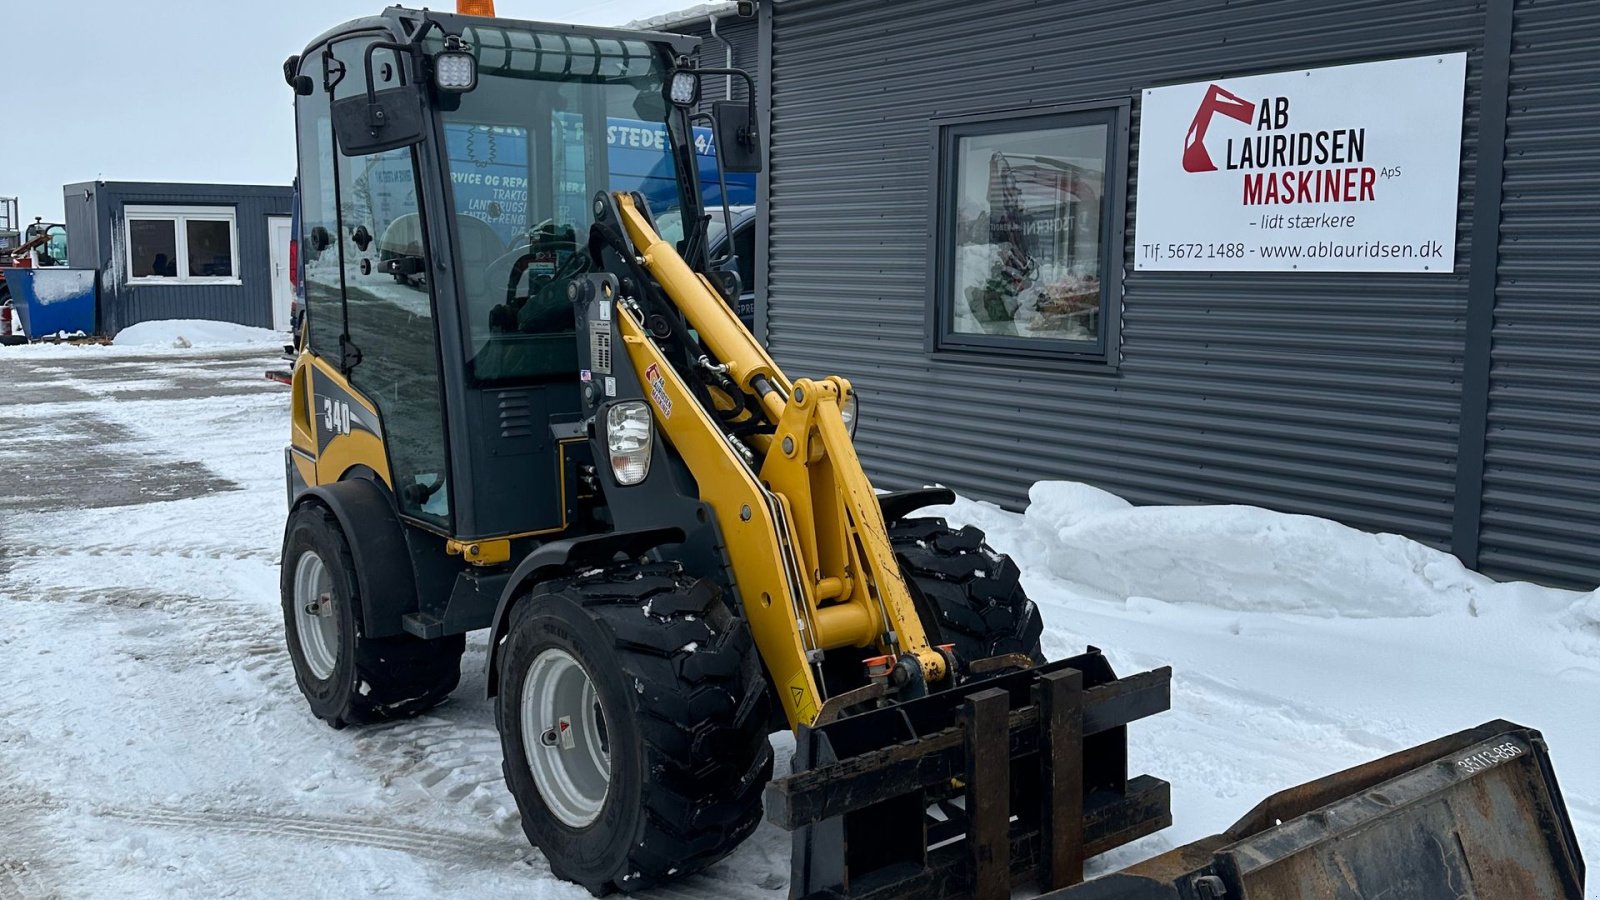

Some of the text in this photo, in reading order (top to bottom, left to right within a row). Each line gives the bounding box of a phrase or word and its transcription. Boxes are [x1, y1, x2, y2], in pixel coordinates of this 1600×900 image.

[1257, 96, 1289, 131] AB
[1226, 128, 1365, 170] LAURIDSEN
[451, 172, 482, 185] RVICE
[485, 175, 499, 186] OG
[502, 176, 528, 188] REPA
[493, 188, 528, 201] TRAKTO
[1241, 165, 1402, 206] MASKINER ApS
[1260, 213, 1285, 230] lidt
[1287, 212, 1356, 229] stærkere
[1142, 243, 1164, 263] Tlf.
[1167, 243, 1203, 259] 5672
[1207, 242, 1245, 259] 1488
[1259, 239, 1443, 259] www.ablauridsen.dk
[324, 397, 351, 437] 340
[1457, 742, 1522, 774] 35113-856
